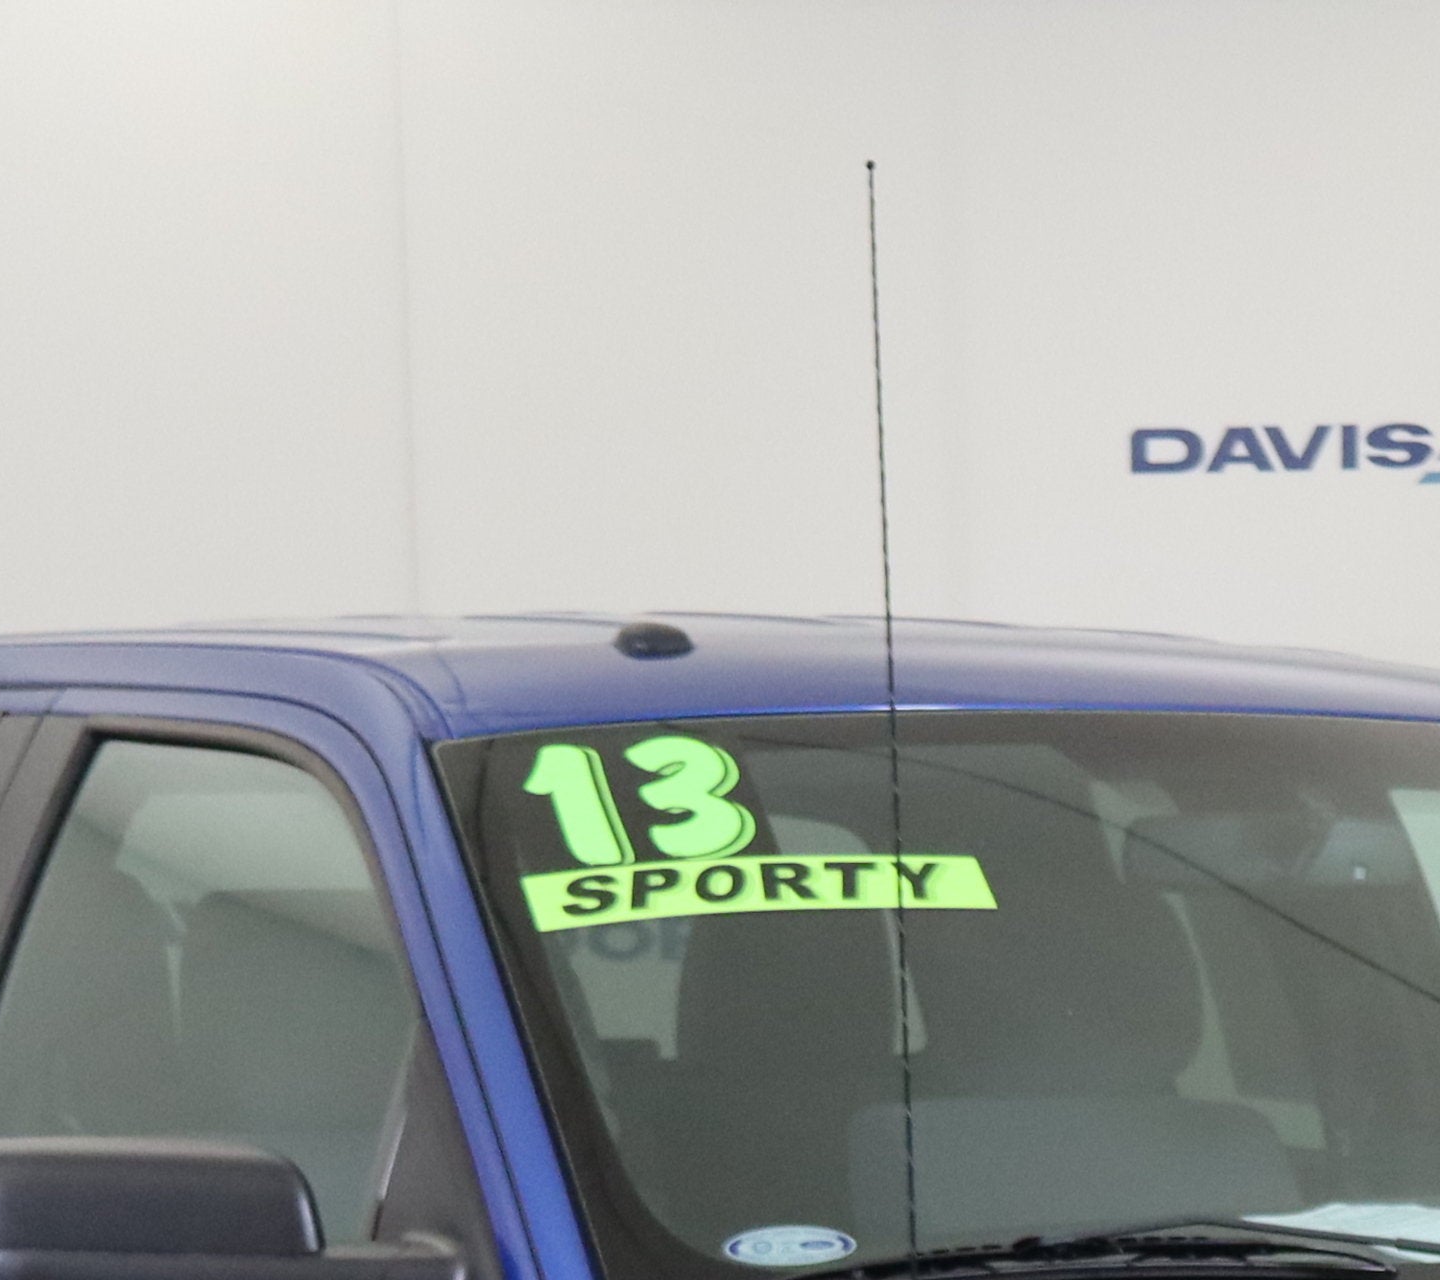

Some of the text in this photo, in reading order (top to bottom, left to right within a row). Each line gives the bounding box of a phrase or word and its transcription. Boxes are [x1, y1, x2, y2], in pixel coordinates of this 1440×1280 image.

[1129, 422, 1434, 475] DAVIS
[523, 735, 757, 866] 13
[561, 860, 938, 918] SPORTY
